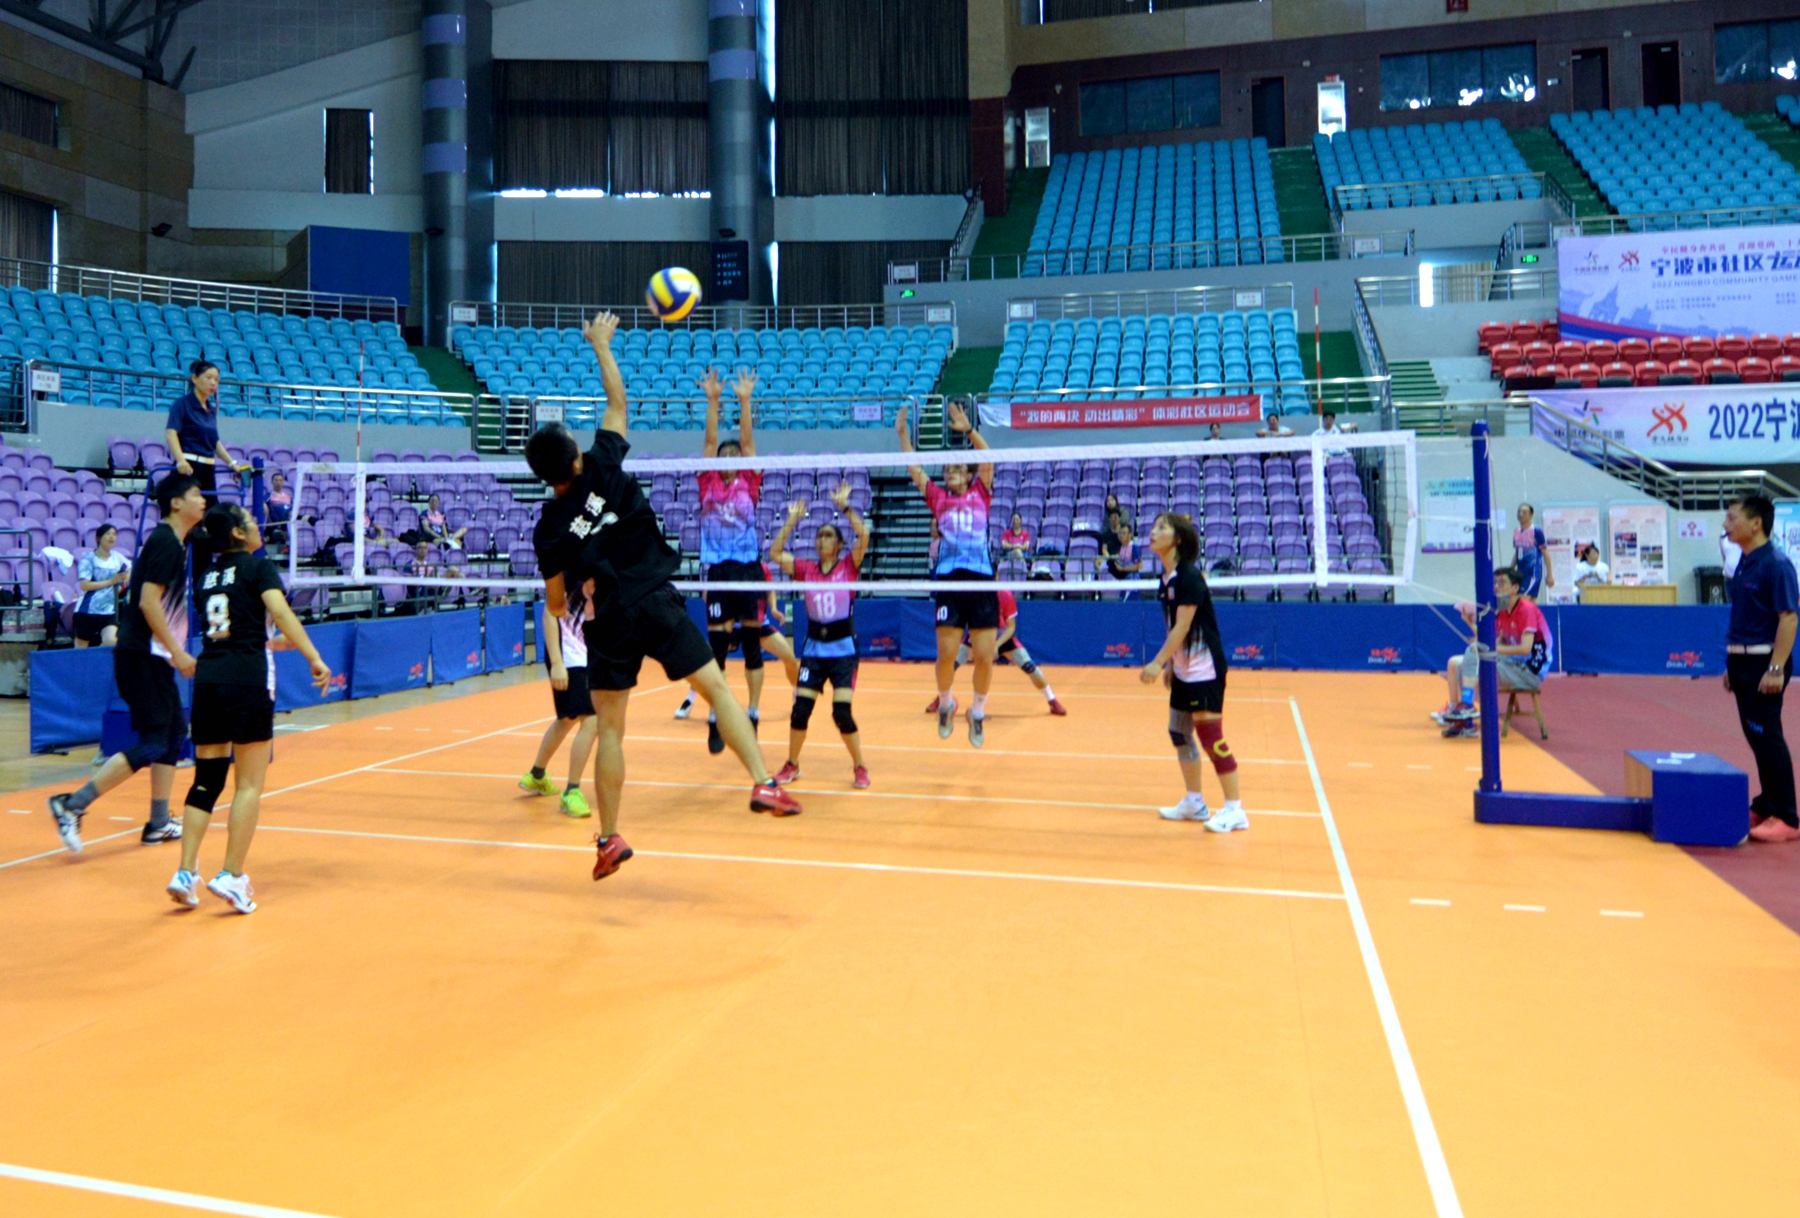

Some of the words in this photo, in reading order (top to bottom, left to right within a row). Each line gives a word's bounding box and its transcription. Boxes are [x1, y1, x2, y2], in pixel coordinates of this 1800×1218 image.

[1771, 272, 1800, 282] GAME
[948, 508, 973, 533] 10
[813, 591, 837, 619] 18
